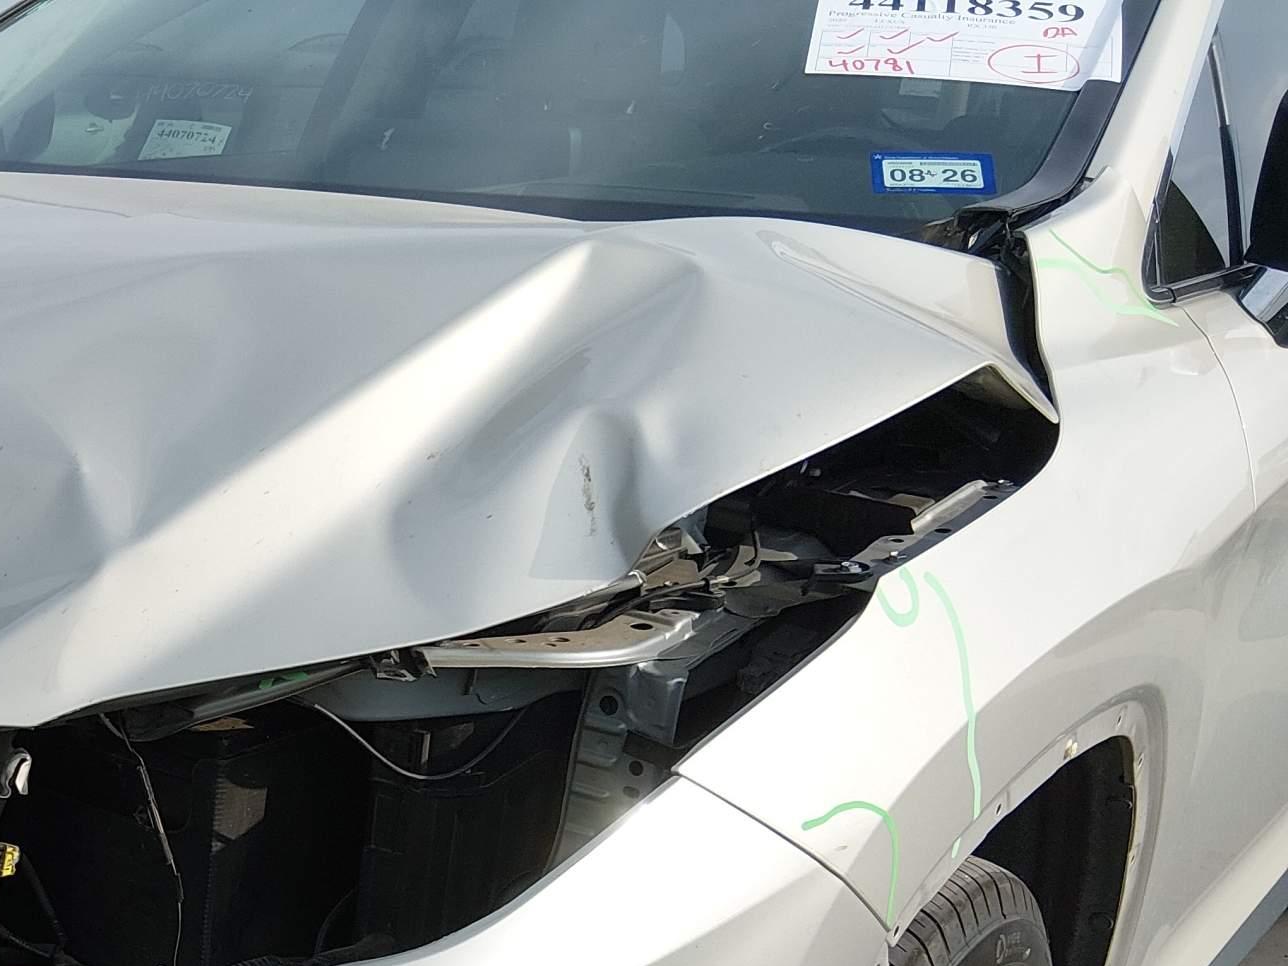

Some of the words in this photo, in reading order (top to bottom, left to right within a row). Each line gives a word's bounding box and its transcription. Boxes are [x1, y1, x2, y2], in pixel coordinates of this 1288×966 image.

[901, 12, 954, 21] Casualty
[957, 15, 1016, 25] Insurance
[828, 58, 915, 75] 40781
[157, 128, 217, 144] 44070724
[889, 168, 926, 182] 08
[941, 168, 978, 183] 26
